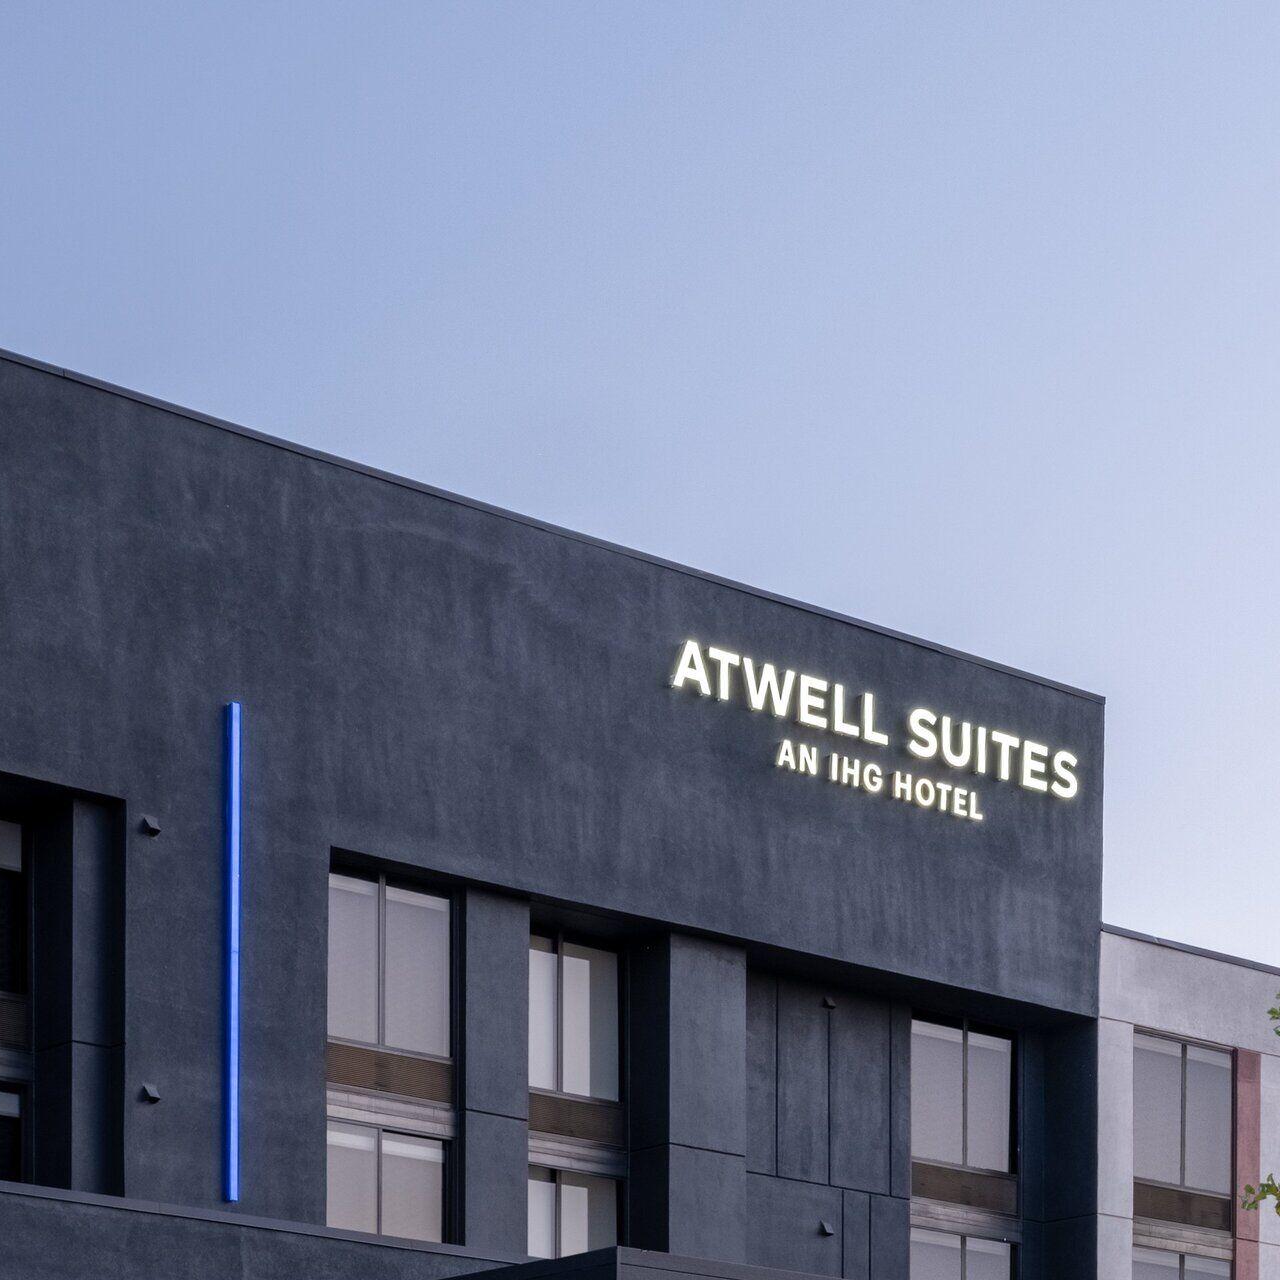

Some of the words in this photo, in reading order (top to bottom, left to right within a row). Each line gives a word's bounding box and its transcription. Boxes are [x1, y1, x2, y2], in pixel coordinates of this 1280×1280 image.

[671, 639, 889, 746] ATWELL
[908, 707, 1079, 799] SUITES
[777, 739, 818, 776] AN
[831, 752, 883, 793] IHG
[894, 770, 983, 821] HOTEL
